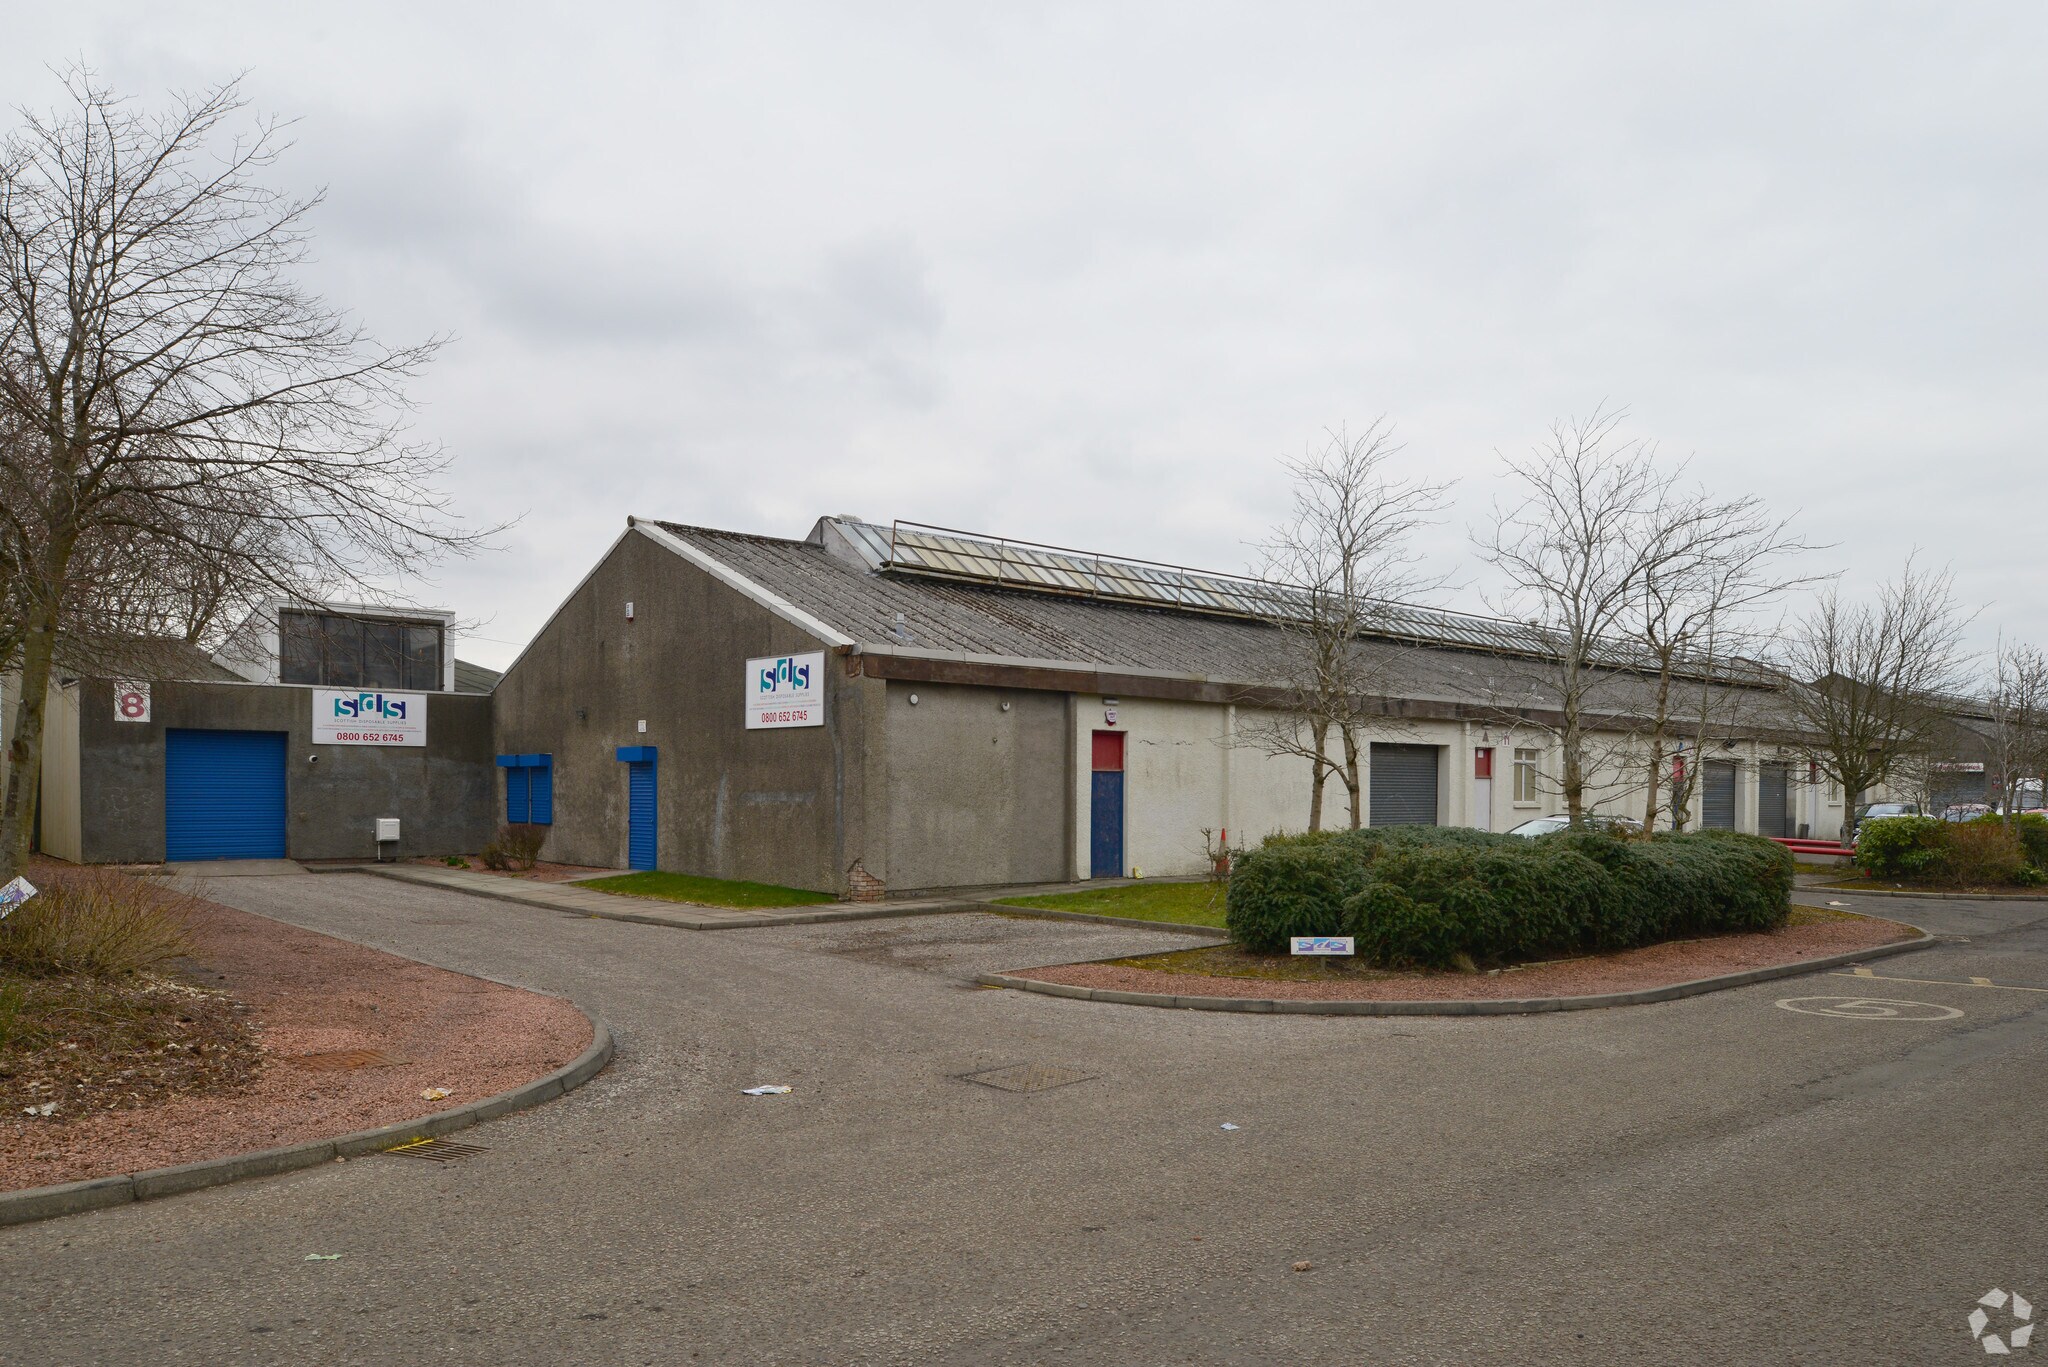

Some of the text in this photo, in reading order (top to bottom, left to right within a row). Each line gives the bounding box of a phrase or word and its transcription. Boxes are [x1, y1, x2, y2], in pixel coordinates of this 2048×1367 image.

[760, 658, 810, 692] sds
[121, 692, 145, 718] 8
[334, 693, 406, 719] sds
[761, 710, 808, 723] 0800 652 6745
[336, 732, 404, 742] 0800 652 6745
